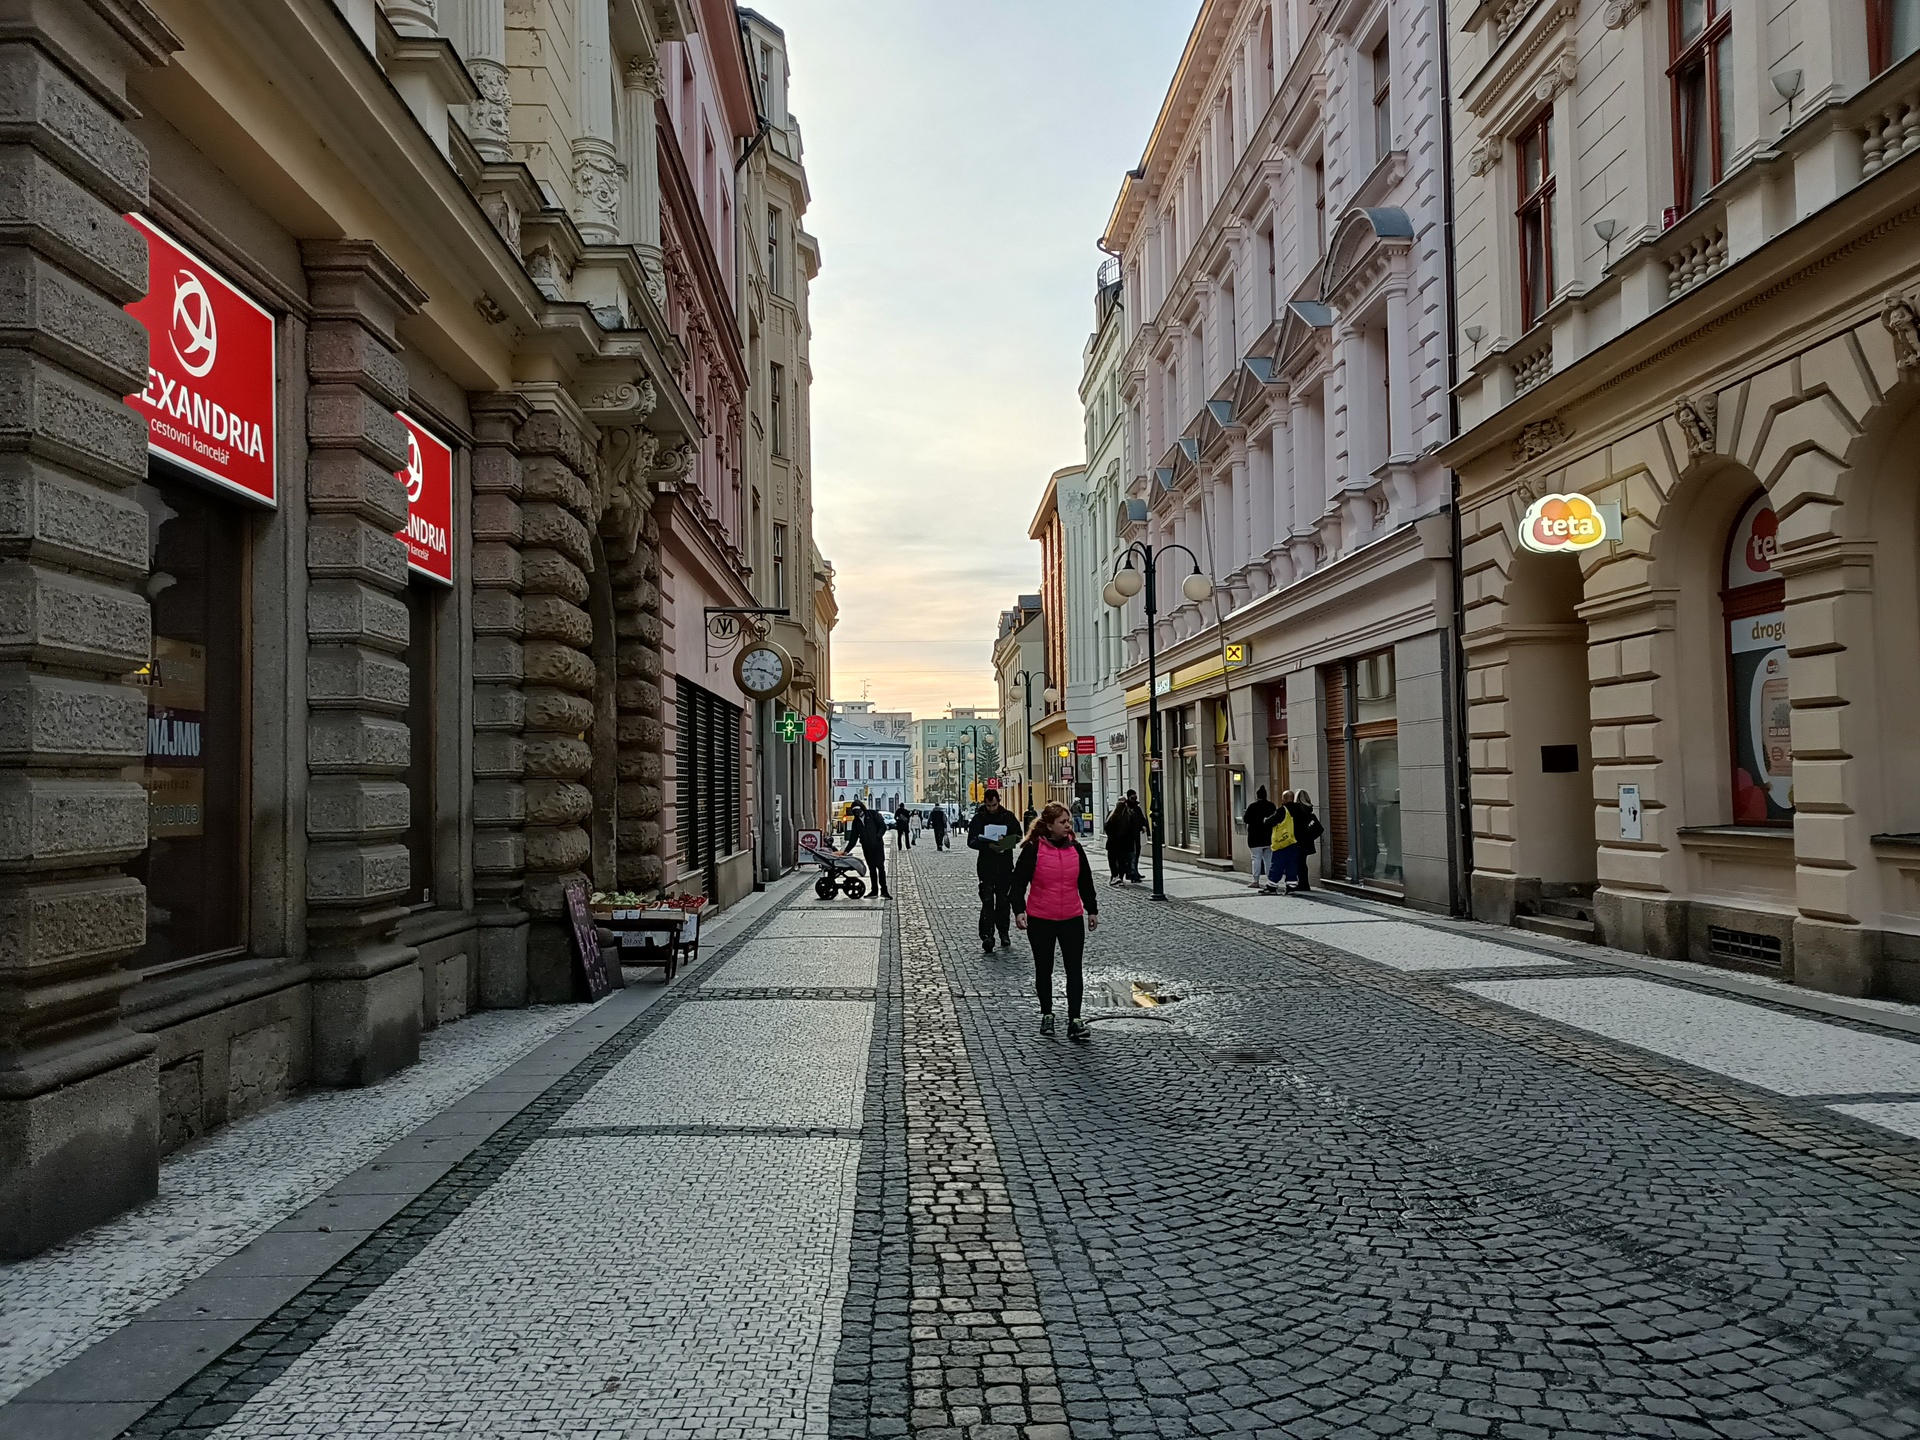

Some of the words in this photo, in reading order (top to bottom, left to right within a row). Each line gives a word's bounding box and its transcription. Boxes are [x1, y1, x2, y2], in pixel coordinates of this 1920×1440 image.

[131, 367, 266, 463] EXANDRIA
[151, 418, 190, 447] cestovní
[192, 434, 230, 466] kancelář
[400, 512, 447, 555] ANDRIA
[1541, 516, 1594, 538] teta
[1752, 531, 1781, 561] te
[1751, 621, 1786, 641] drog
[147, 713, 201, 756] NÁJMU
